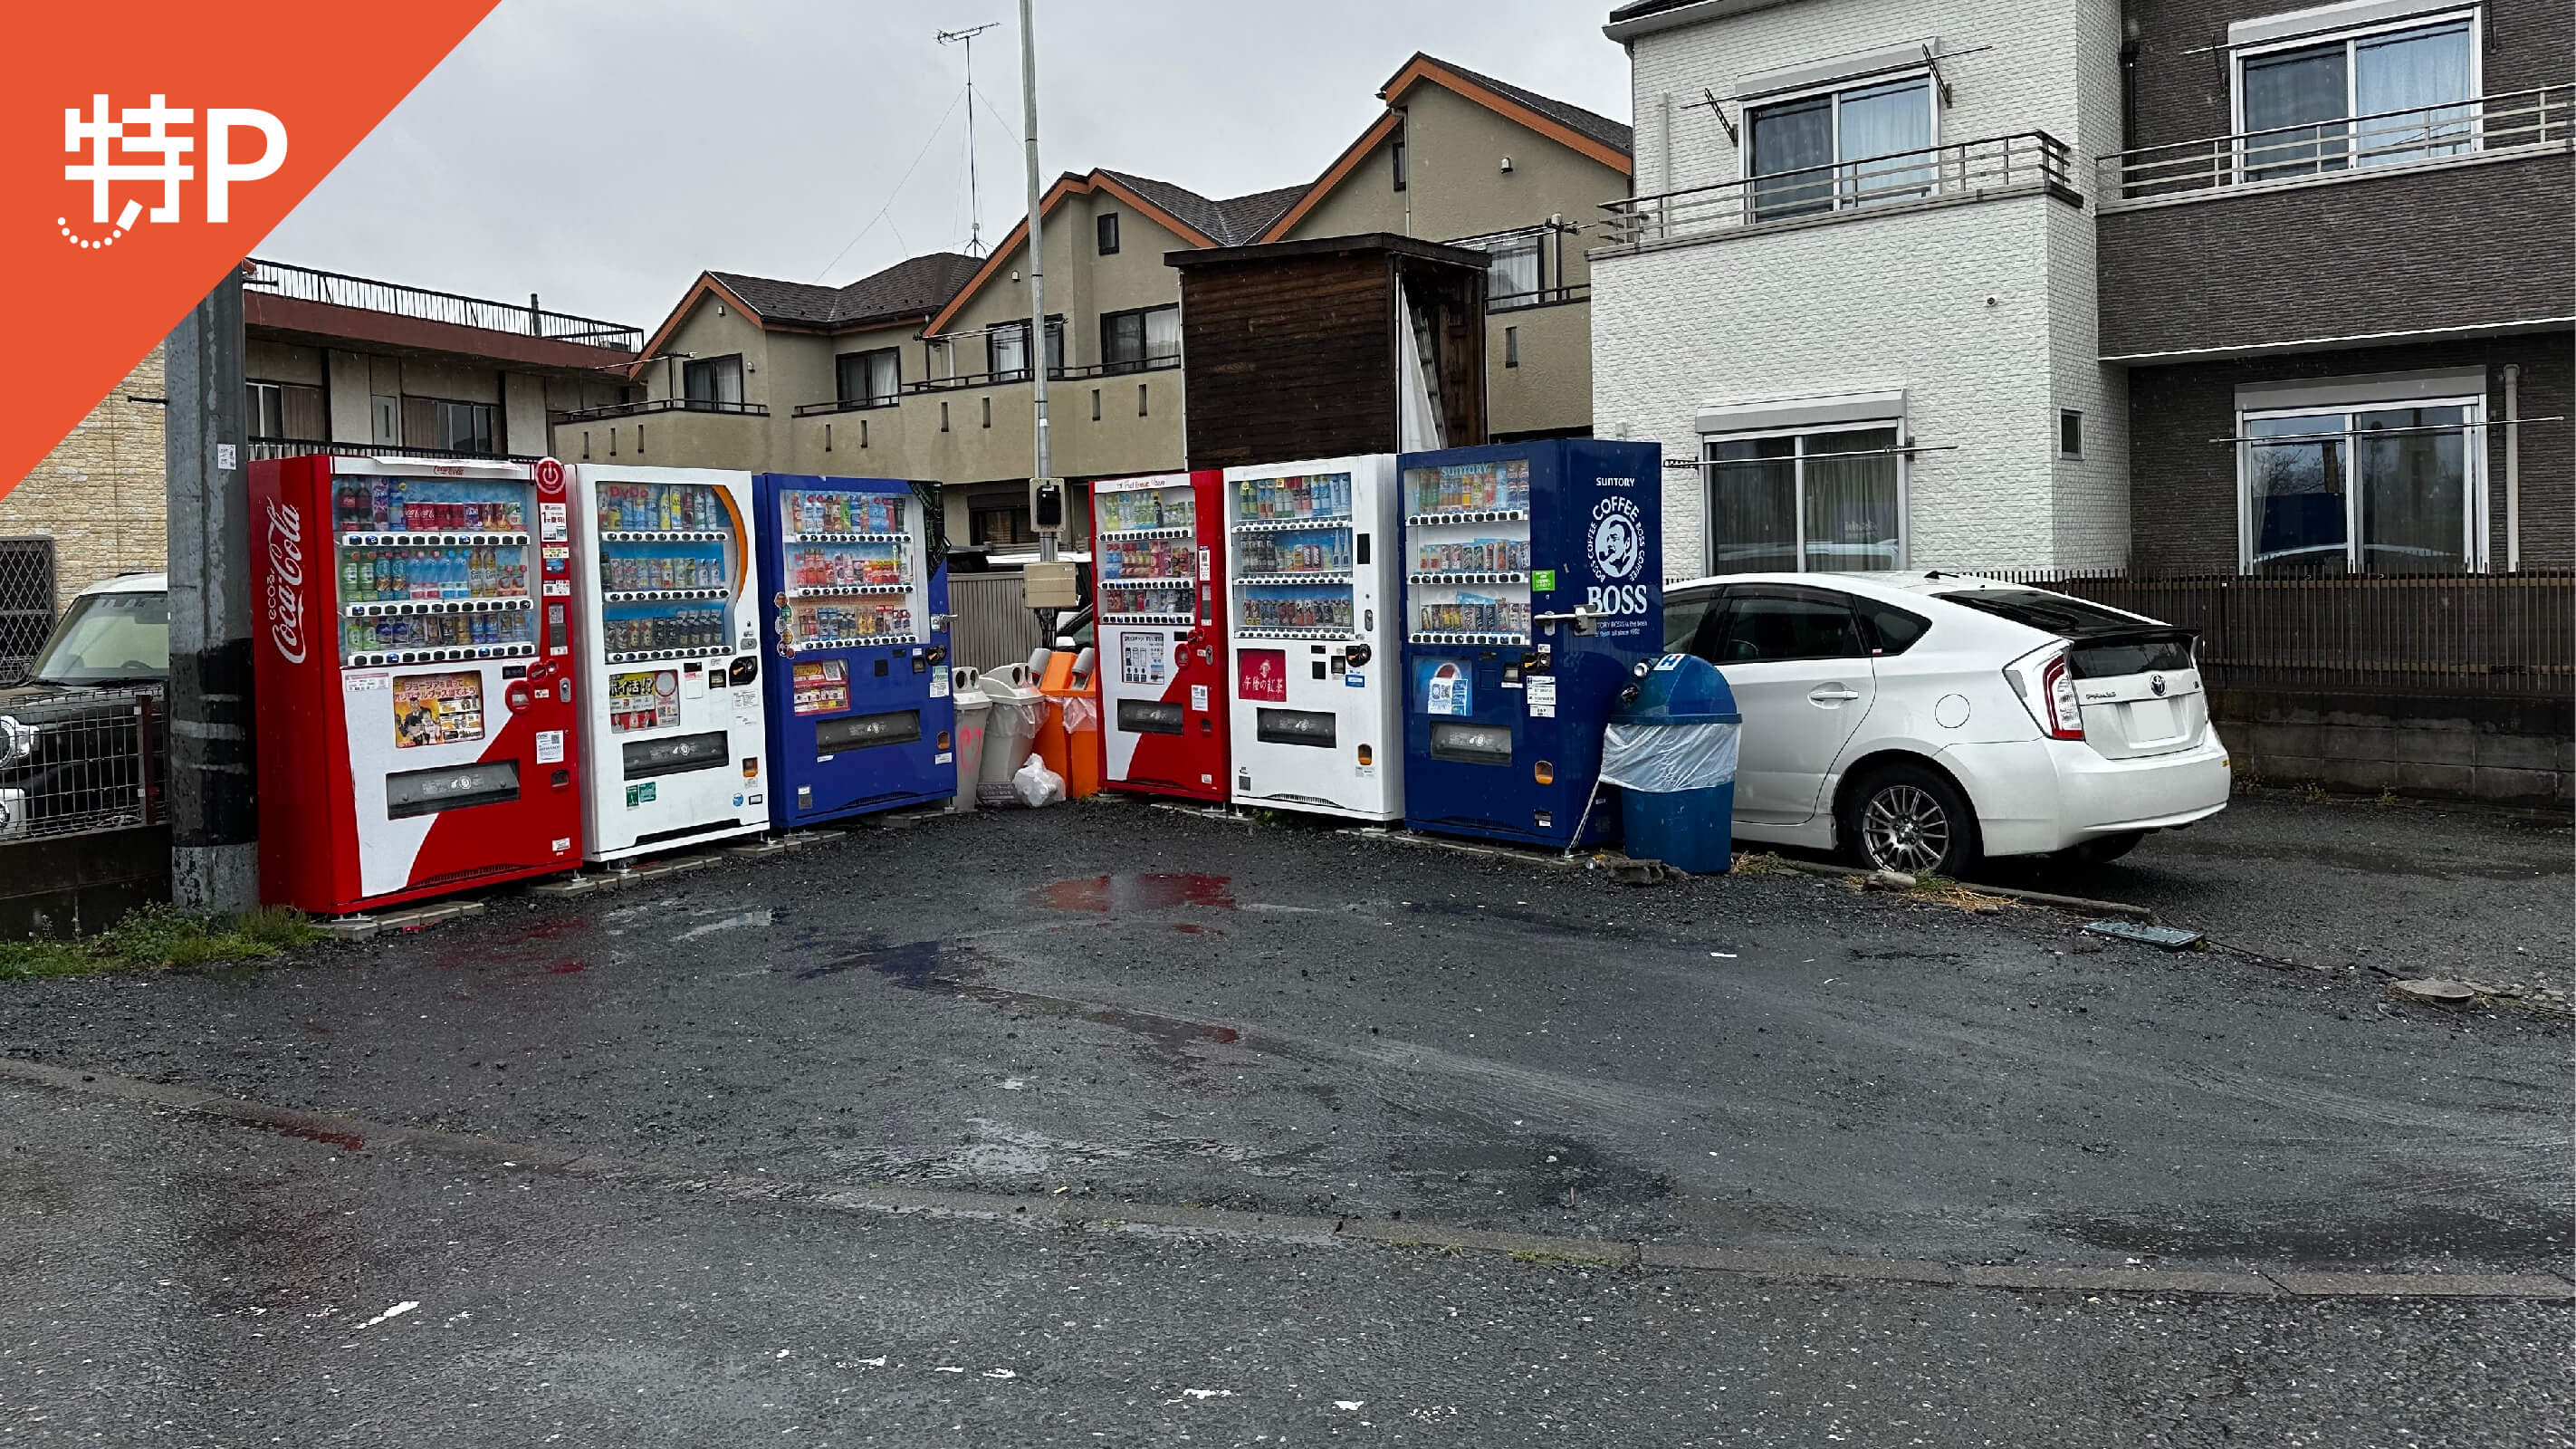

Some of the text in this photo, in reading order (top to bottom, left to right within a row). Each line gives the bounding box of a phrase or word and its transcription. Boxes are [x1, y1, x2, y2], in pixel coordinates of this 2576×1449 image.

[609, 485, 649, 500] DyDo
[1595, 477, 1635, 486] SUNTORY
[1593, 495, 1640, 523] COFFEE
[1587, 522, 1606, 583] BOSS COFFEE
[1629, 522, 1645, 581] BOSS COFFEE
[266, 495, 306, 664] Coca-Cola
[1586, 584, 1648, 615] BOSS
